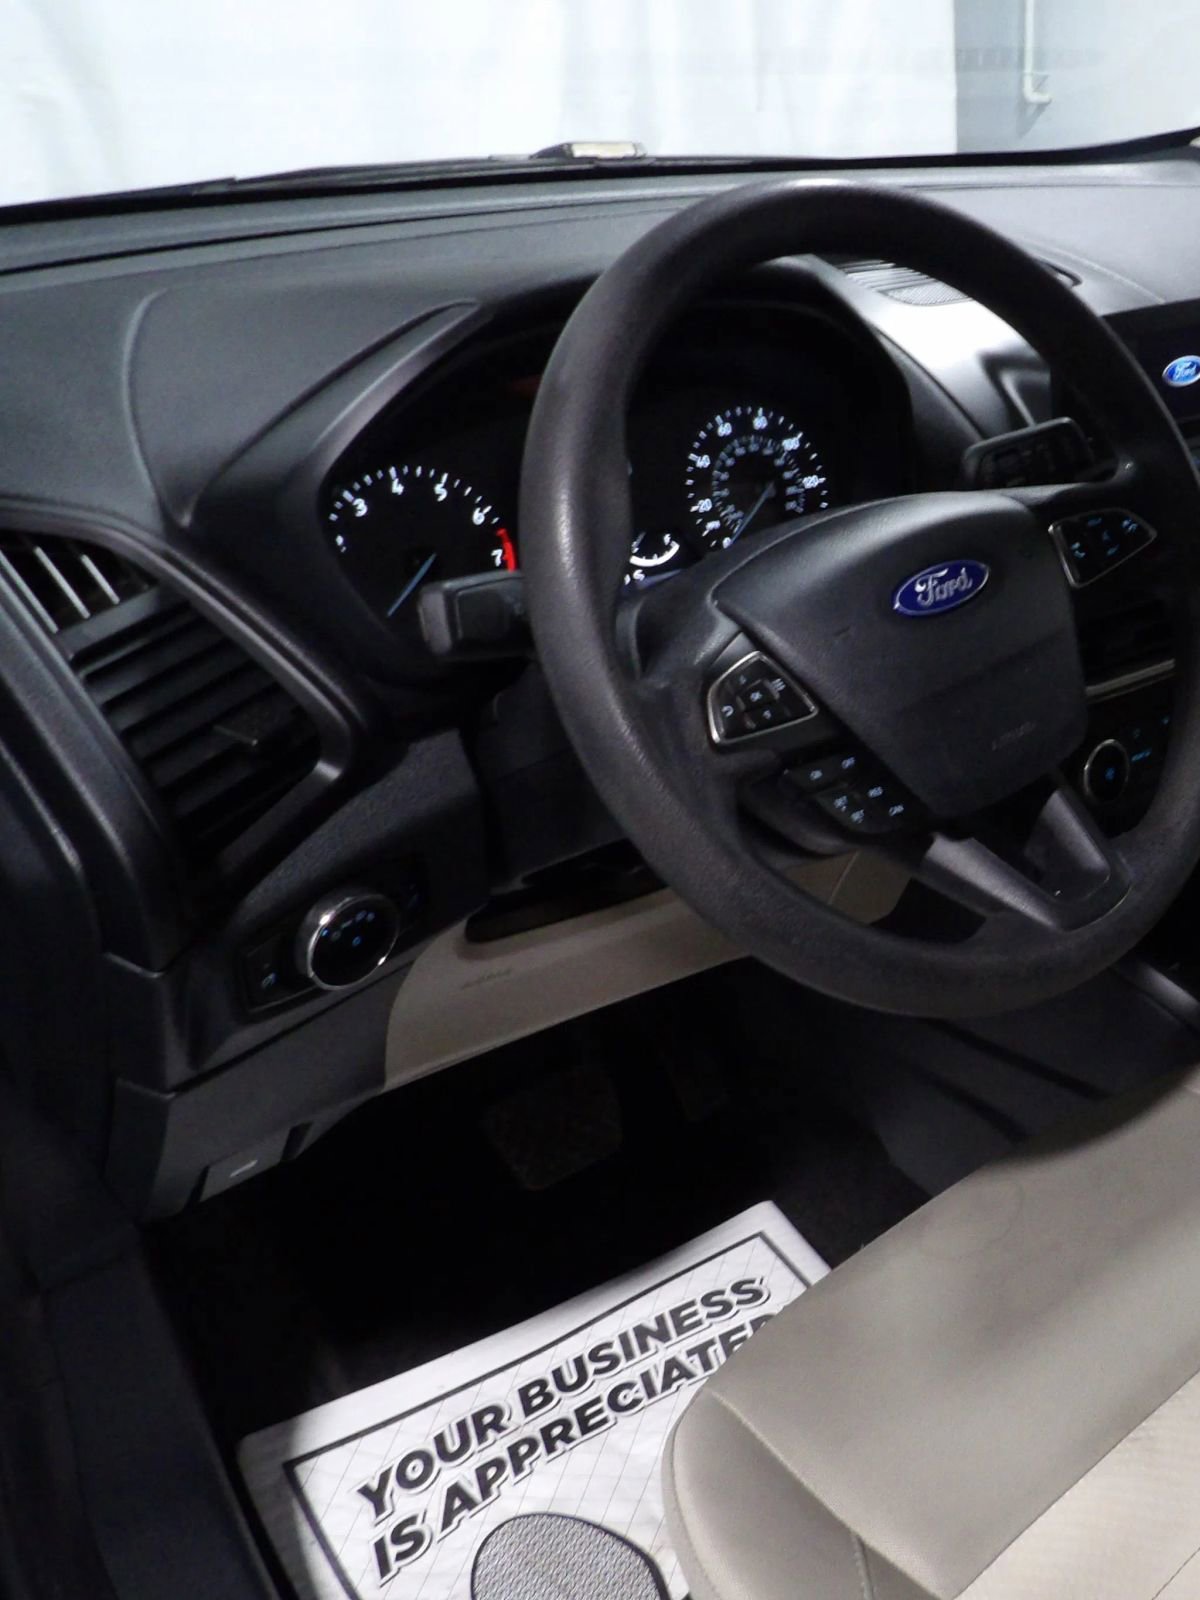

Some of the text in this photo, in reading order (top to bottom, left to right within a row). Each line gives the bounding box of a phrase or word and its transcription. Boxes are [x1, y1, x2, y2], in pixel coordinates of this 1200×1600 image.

[391, 478, 405, 495] 4
[434, 483, 447, 501] 5
[352, 498, 368, 517] 3
[472, 507, 485, 526] 6
[491, 548, 502, 566] 7
[914, 567, 973, 608] Ford
[356, 1277, 769, 1517] YOUR BUSINESS
[370, 1313, 775, 1581] IS APPRECIATE
